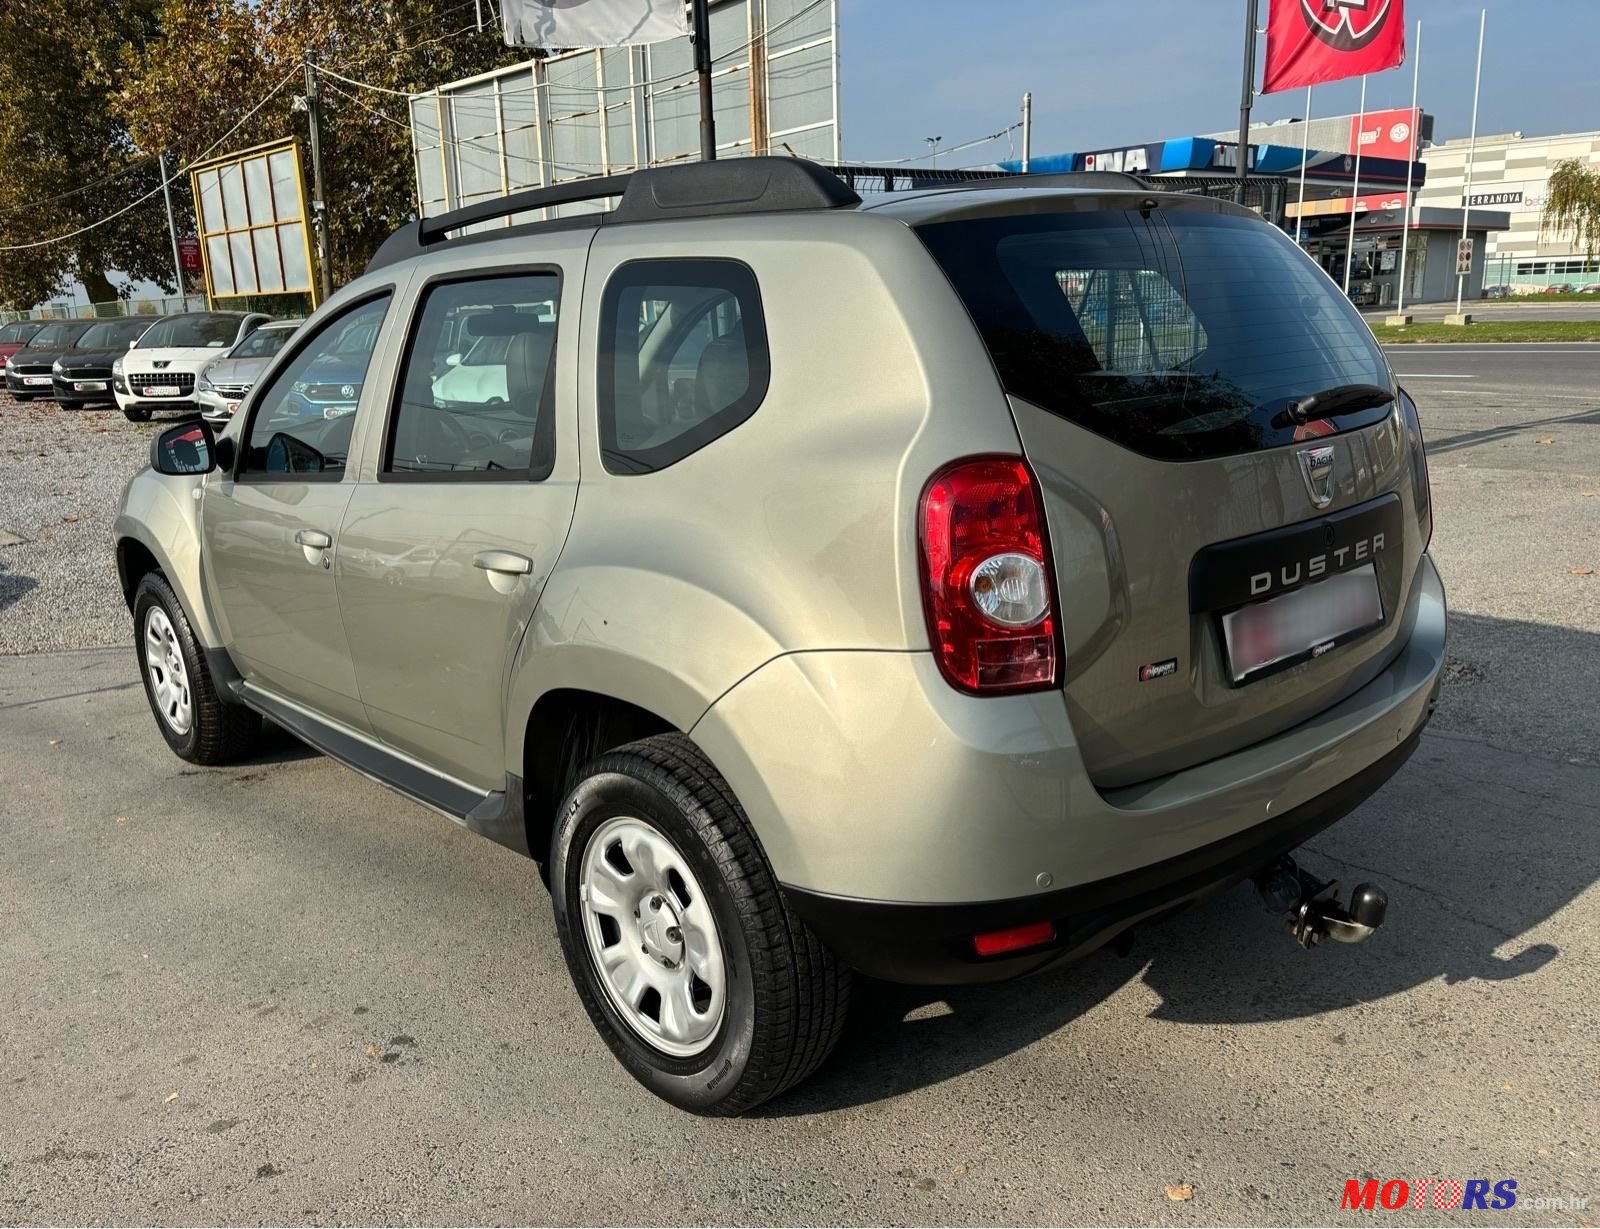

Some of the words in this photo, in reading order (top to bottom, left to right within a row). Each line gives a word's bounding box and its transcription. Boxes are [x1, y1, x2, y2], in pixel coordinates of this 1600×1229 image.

[1085, 148, 1148, 172] INA
[1464, 193, 1520, 205] ERRANOVA
[1310, 455, 1334, 468] DACIA
[1250, 532, 1385, 596] DUSTER
